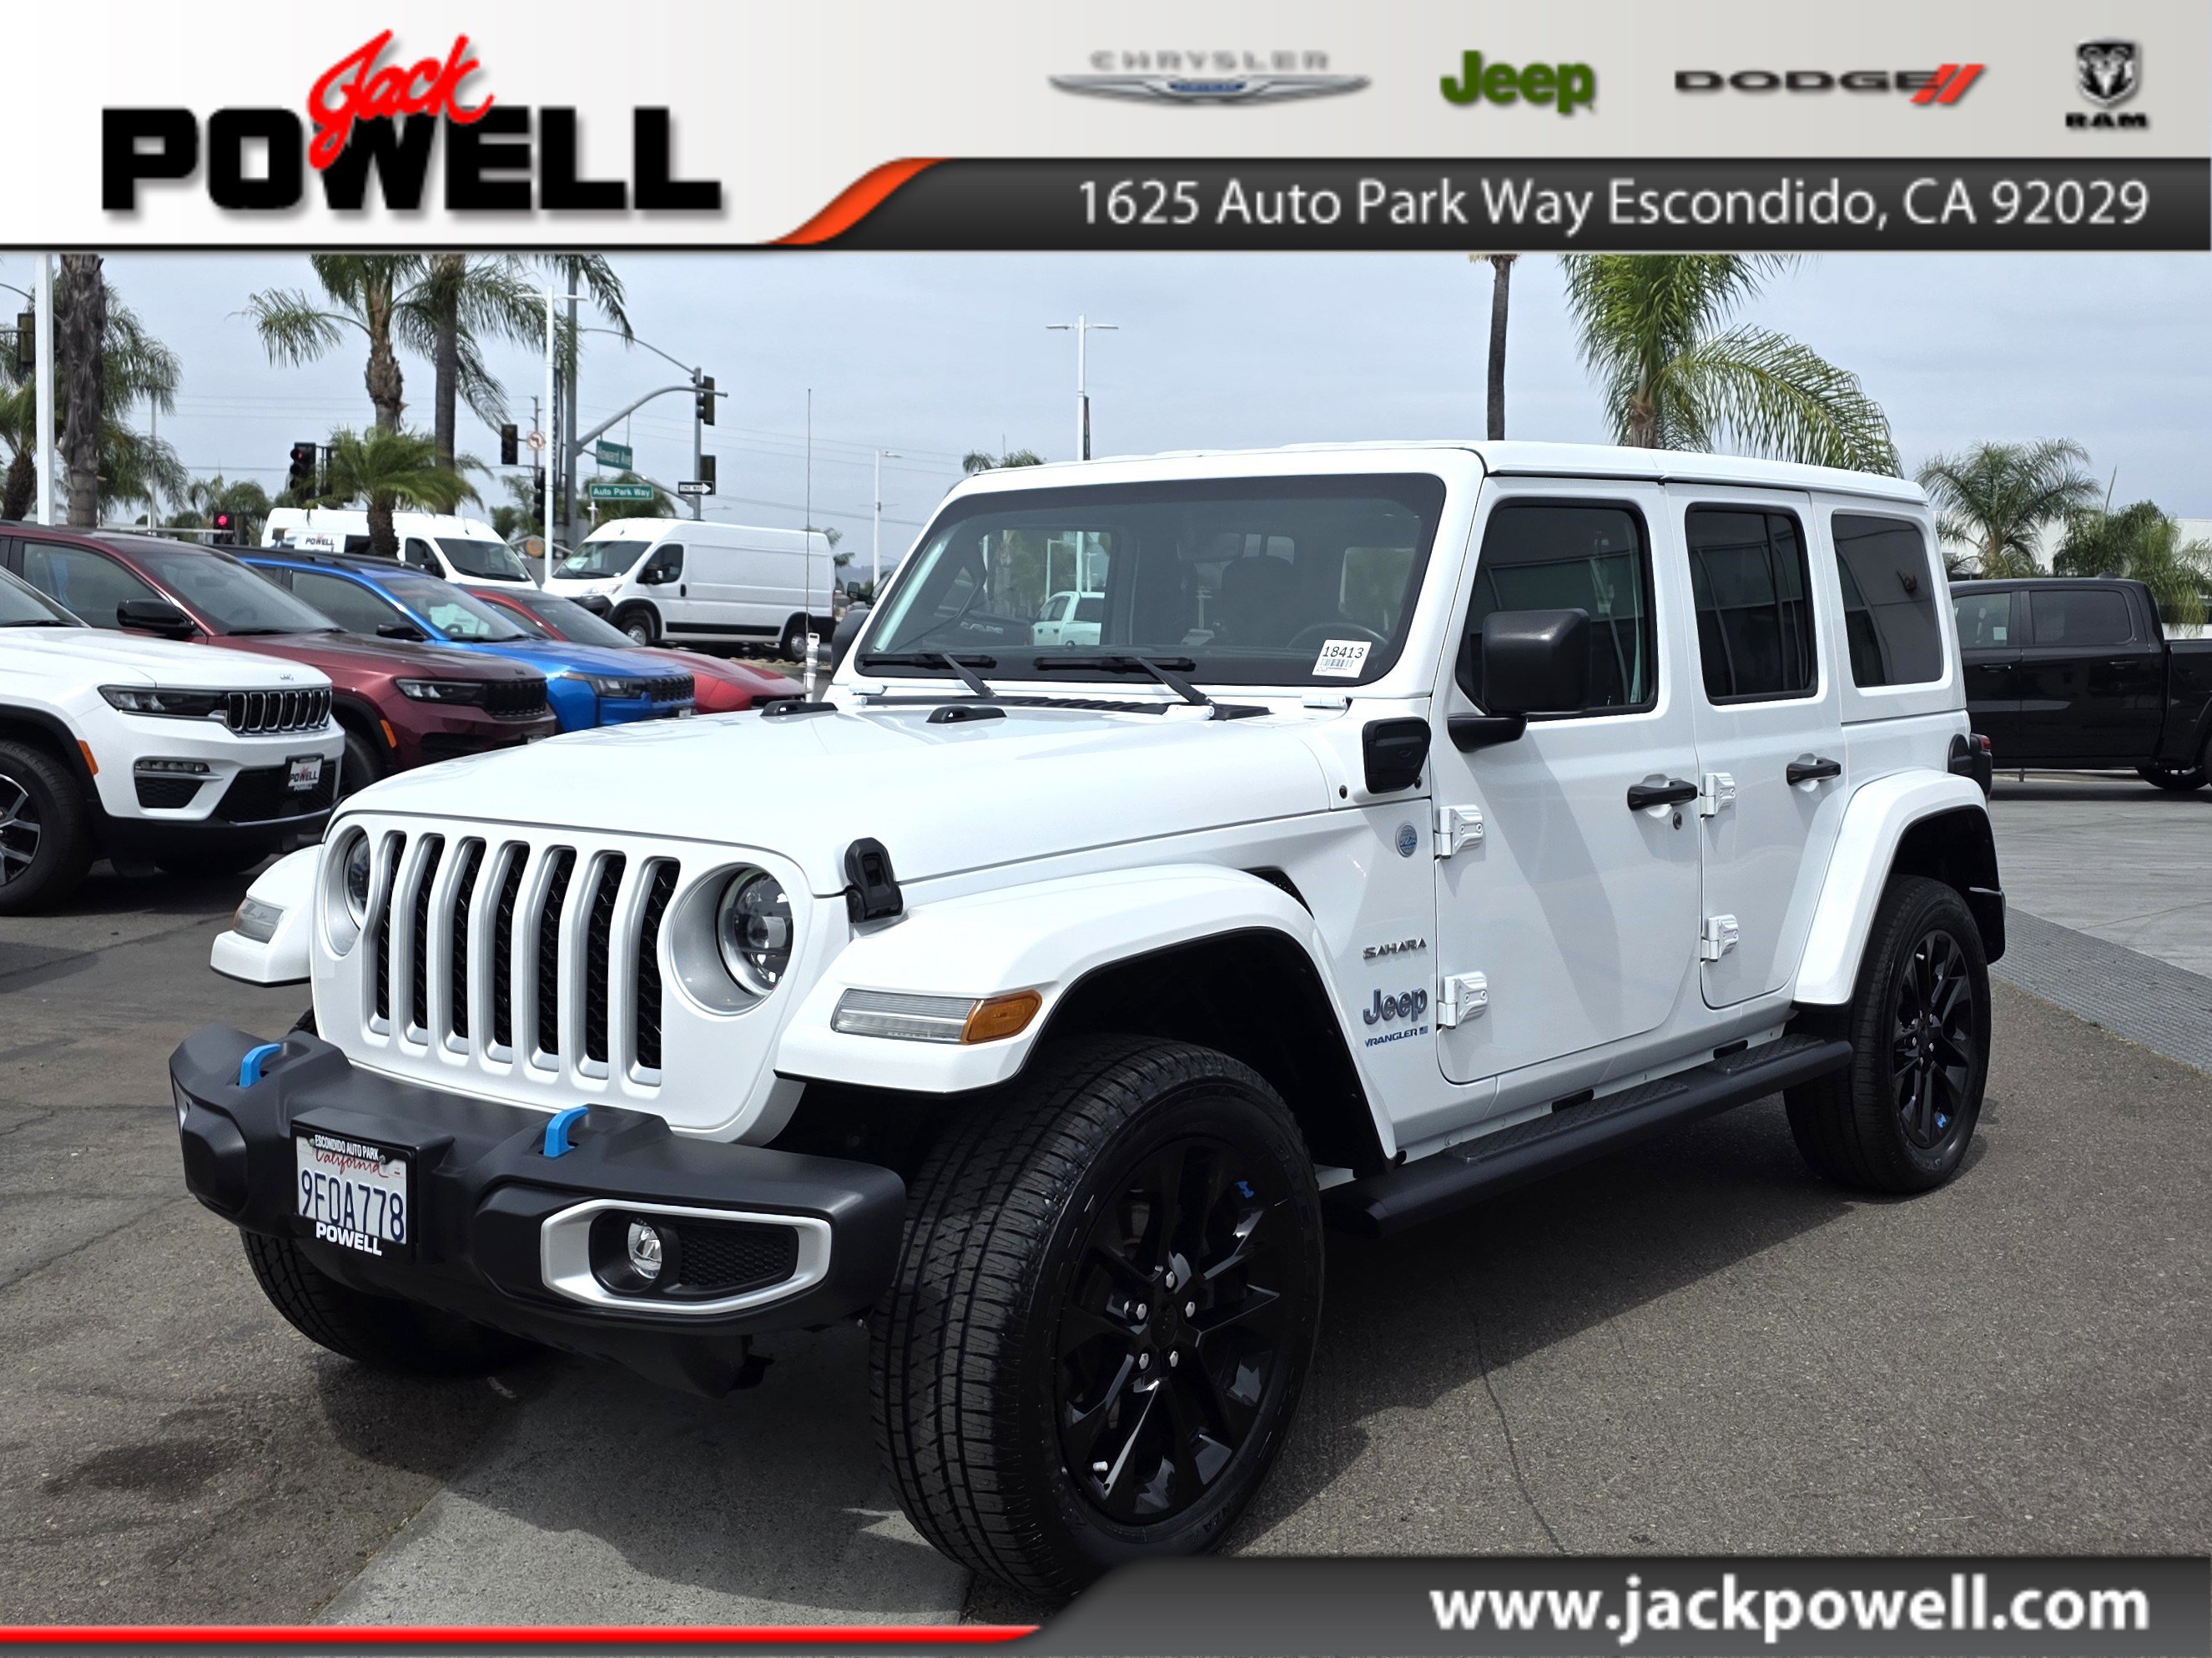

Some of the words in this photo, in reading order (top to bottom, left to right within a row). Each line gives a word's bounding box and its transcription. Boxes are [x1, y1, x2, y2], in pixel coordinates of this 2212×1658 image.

[593, 487, 612, 496] Auto
[613, 487, 632, 496] Park
[634, 488, 651, 498] Way
[1323, 646, 1364, 659] 18413
[1363, 937, 1427, 960] SAHARA
[1363, 988, 1428, 1026] Jeep
[315, 1134, 345, 1153] ESCONDIDO
[346, 1141, 362, 1157] AUTO
[362, 1146, 379, 1162] PARK
[316, 1149, 389, 1178] California
[316, 1221, 383, 1257] POWELL
